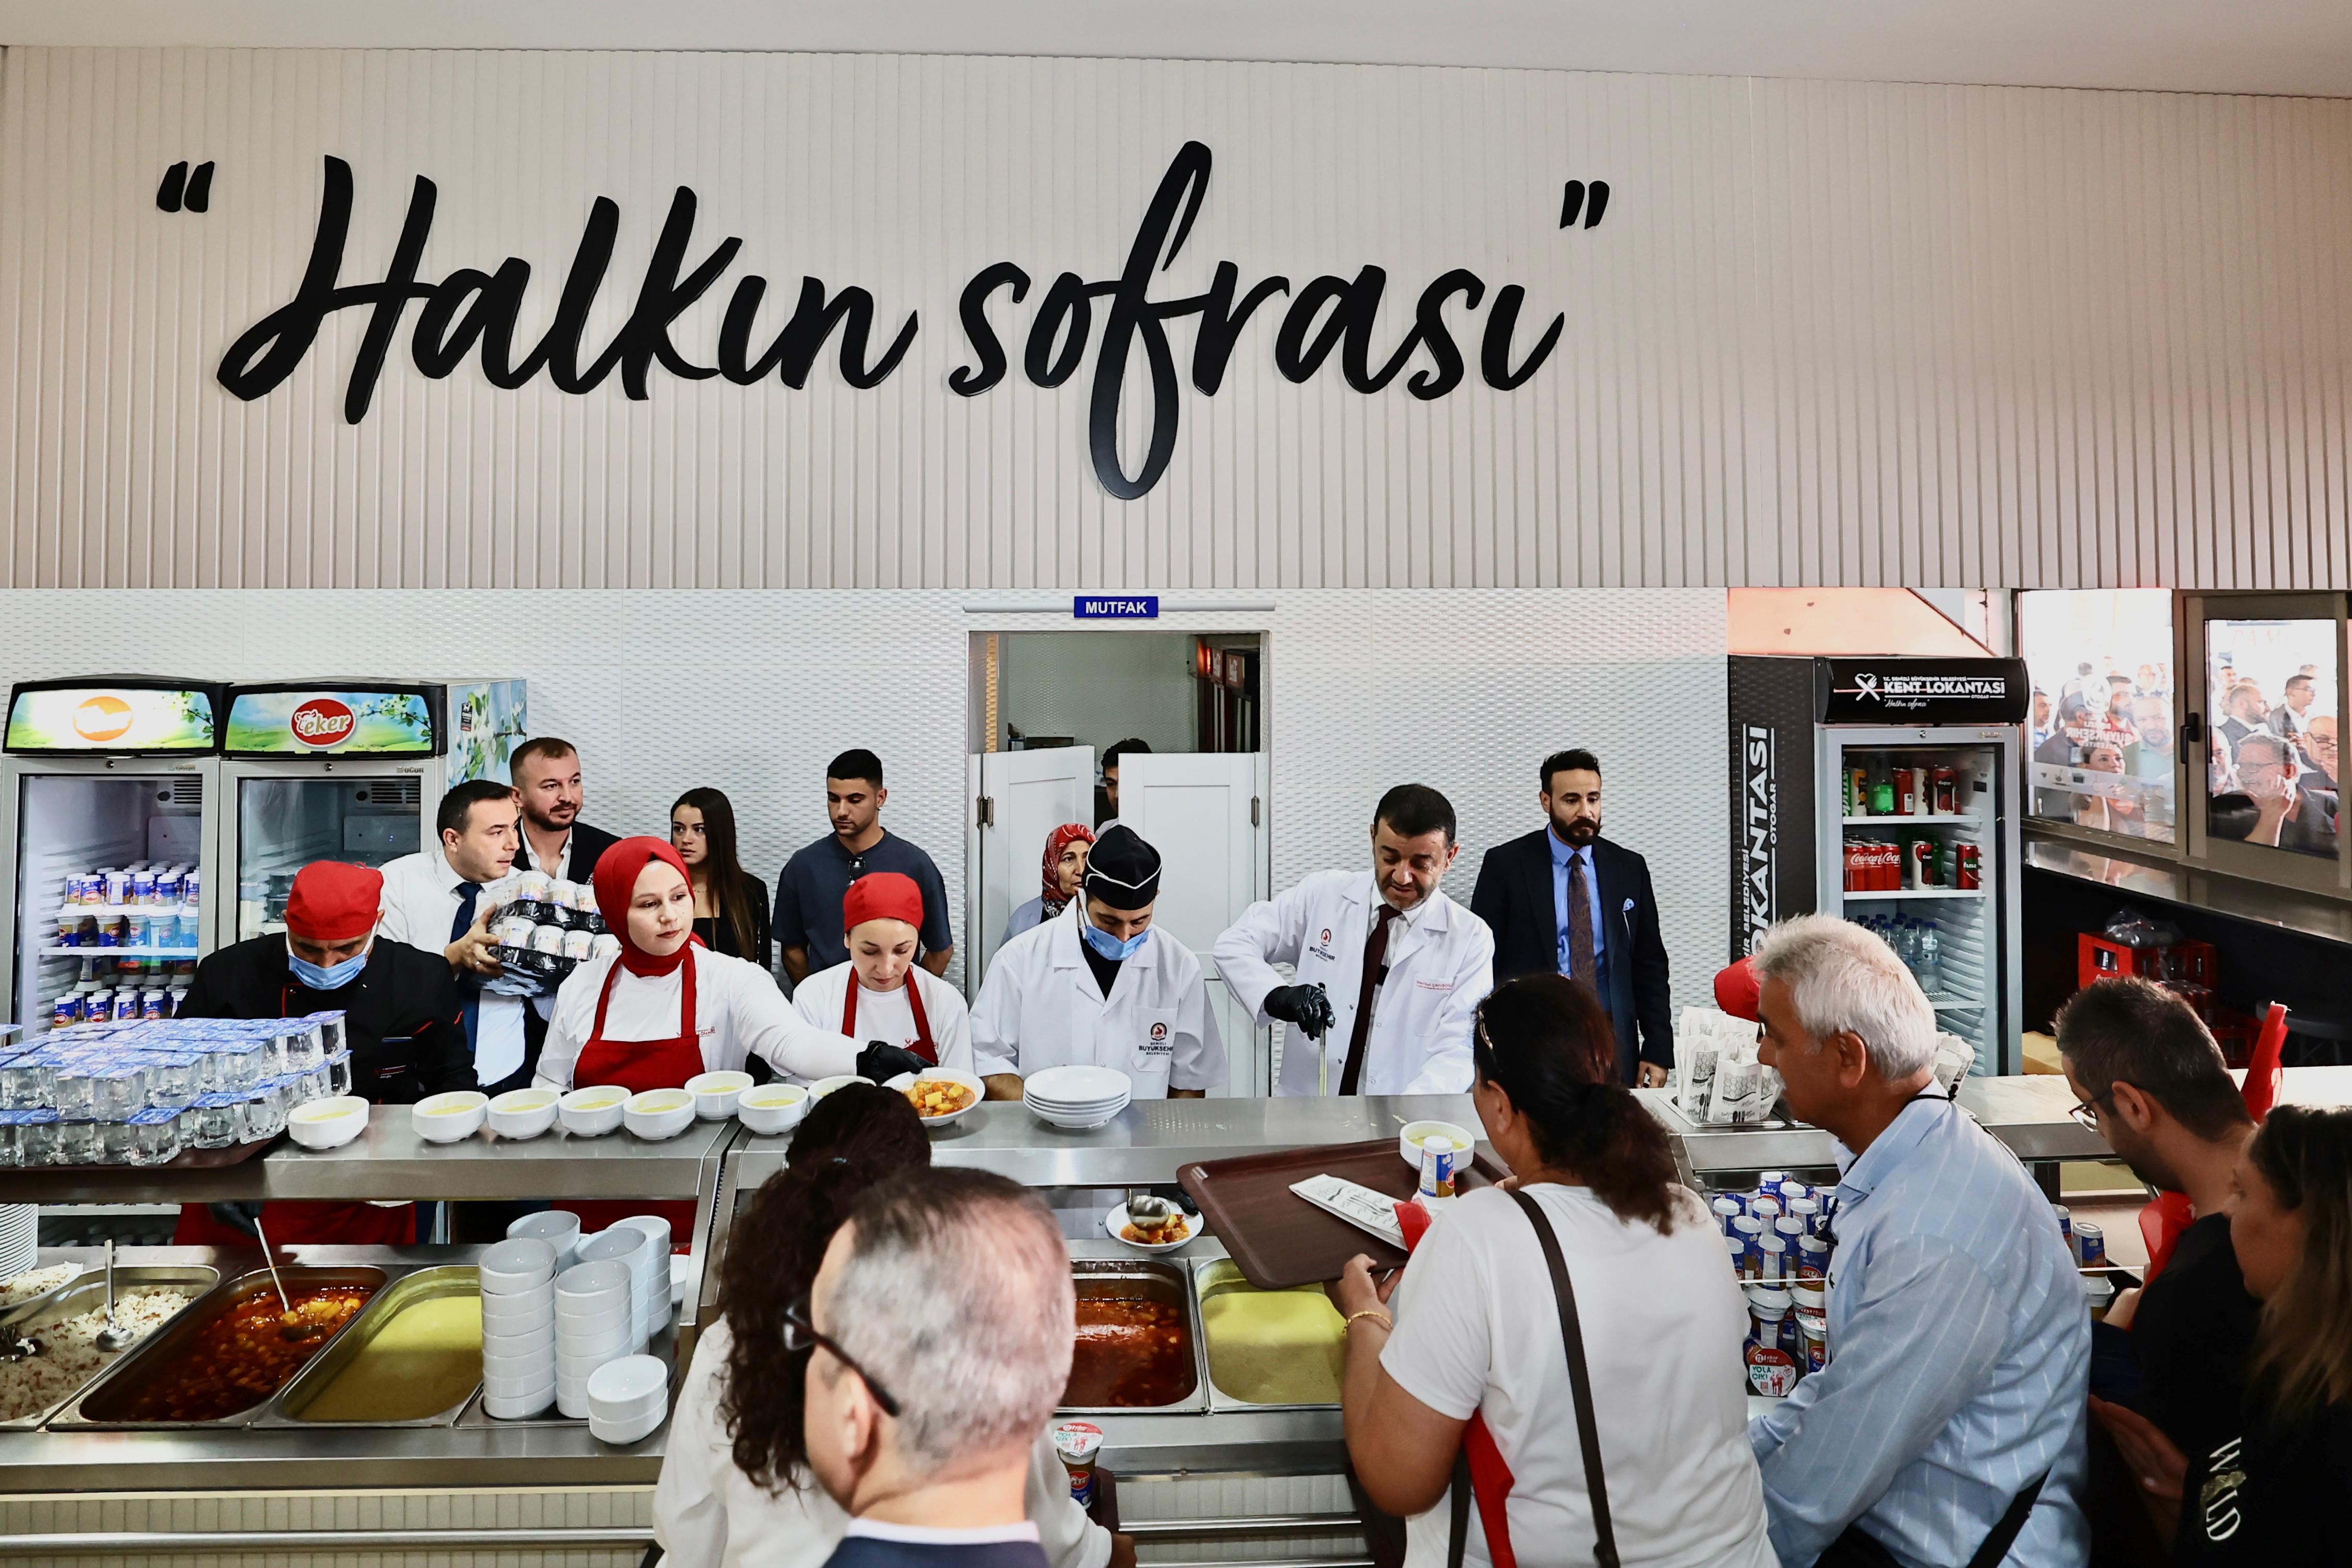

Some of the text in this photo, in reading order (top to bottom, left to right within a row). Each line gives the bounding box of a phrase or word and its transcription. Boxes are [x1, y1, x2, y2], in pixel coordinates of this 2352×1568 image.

[1086, 602, 1147, 614] MUTFAK
[1884, 681, 2005, 694] KENT LOKANTASI
[304, 713, 351, 735] eker
[1749, 727, 1768, 957] OKANTASI
[1741, 848, 1750, 933] BELEDİYESİ
